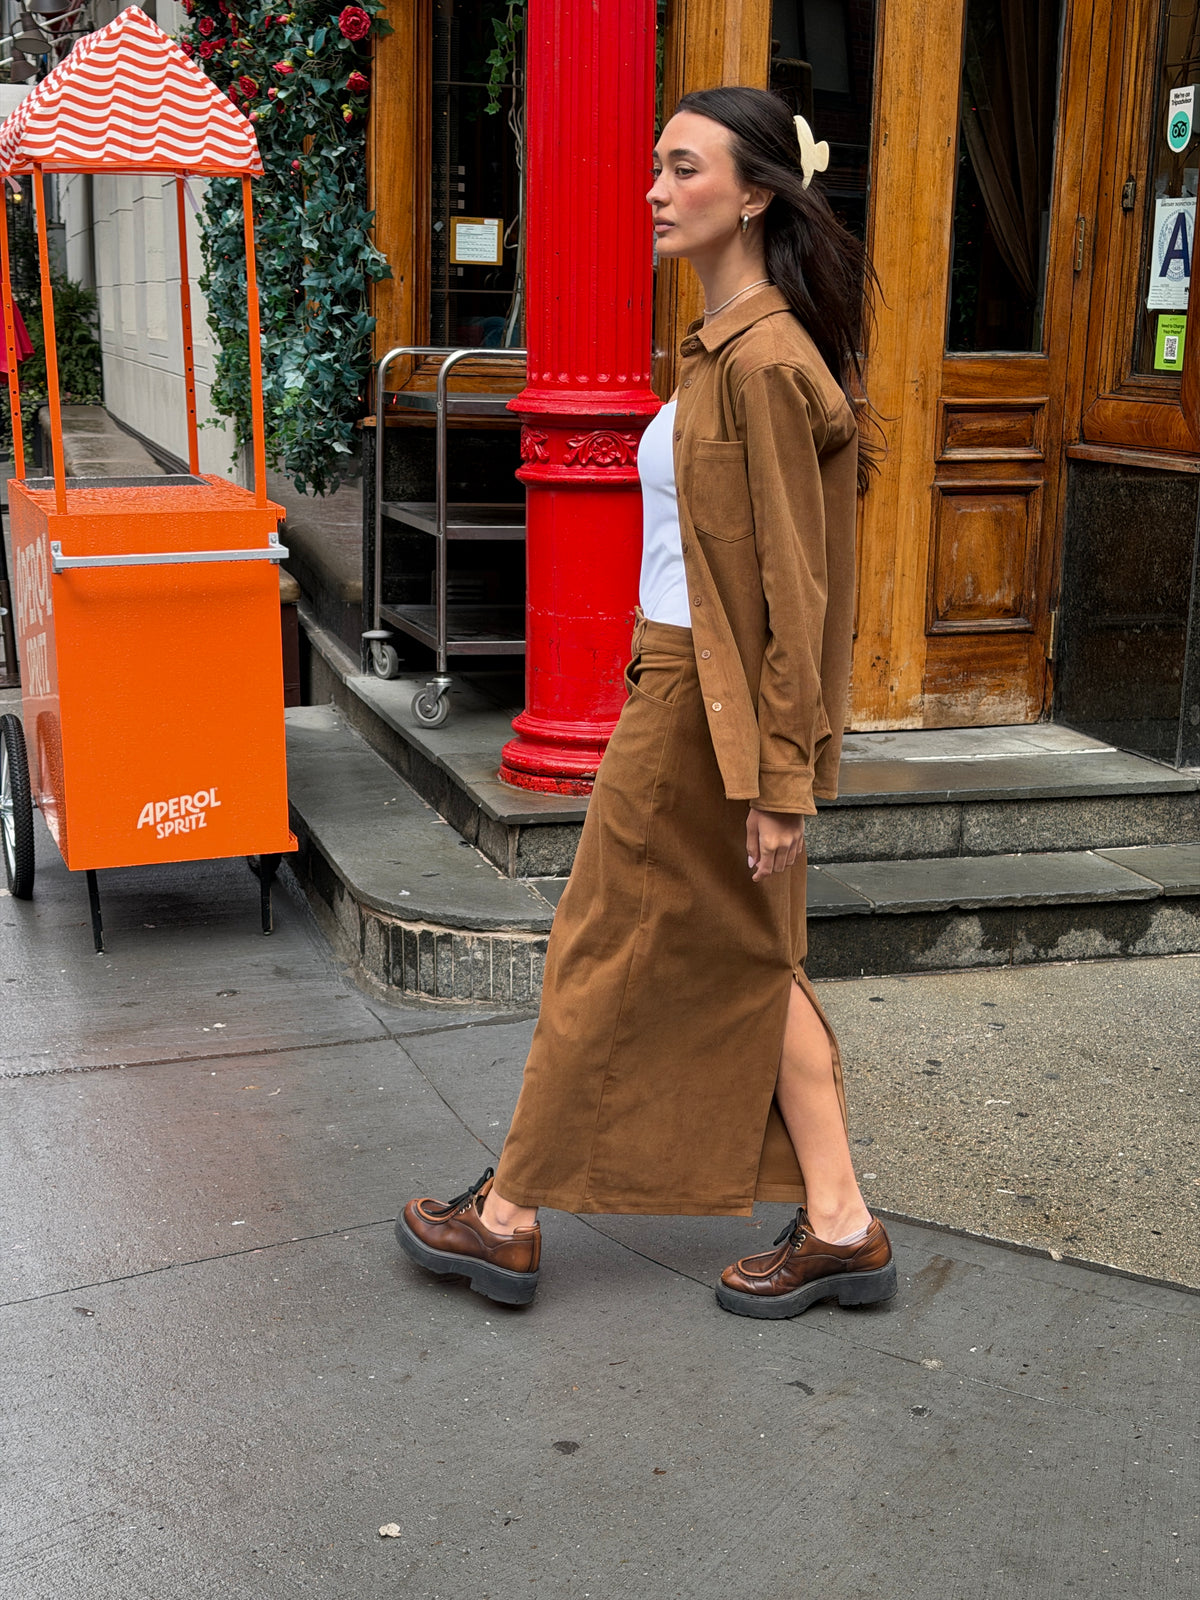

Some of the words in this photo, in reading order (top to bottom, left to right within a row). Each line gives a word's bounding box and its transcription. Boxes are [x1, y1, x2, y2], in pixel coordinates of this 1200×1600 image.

[1159, 212, 1190, 277] A
[16, 533, 52, 637] APEROL
[26, 632, 50, 697] SPRITZ
[137, 787, 221, 829] APEROL
[156, 812, 207, 839] SPRITZ
